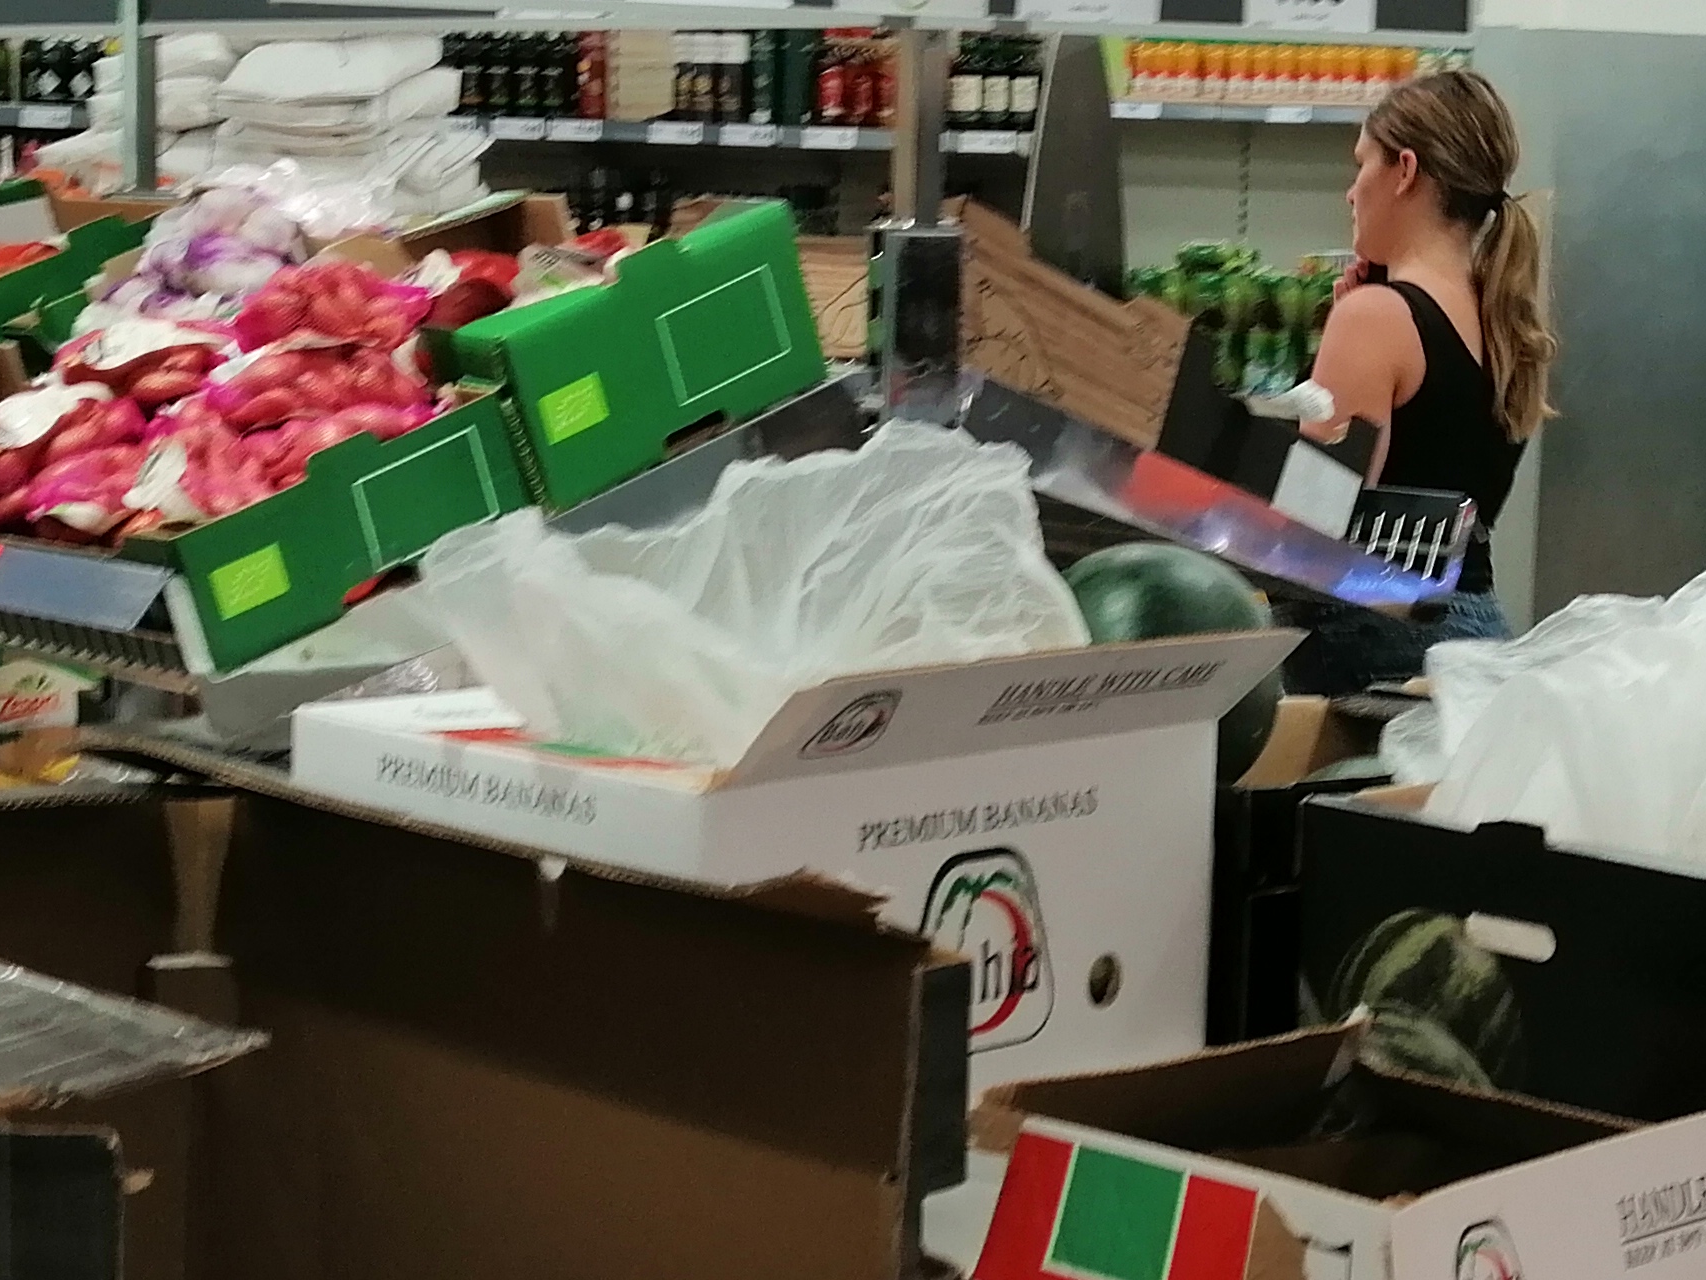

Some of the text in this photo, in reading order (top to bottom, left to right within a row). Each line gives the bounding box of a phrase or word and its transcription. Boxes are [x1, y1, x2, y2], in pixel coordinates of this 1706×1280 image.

[995, 659, 1226, 706] HANDLE WITH CARE
[375, 752, 598, 826] PREMIUM BANANAS
[857, 784, 1100, 853] PREMIUM BANANAS
